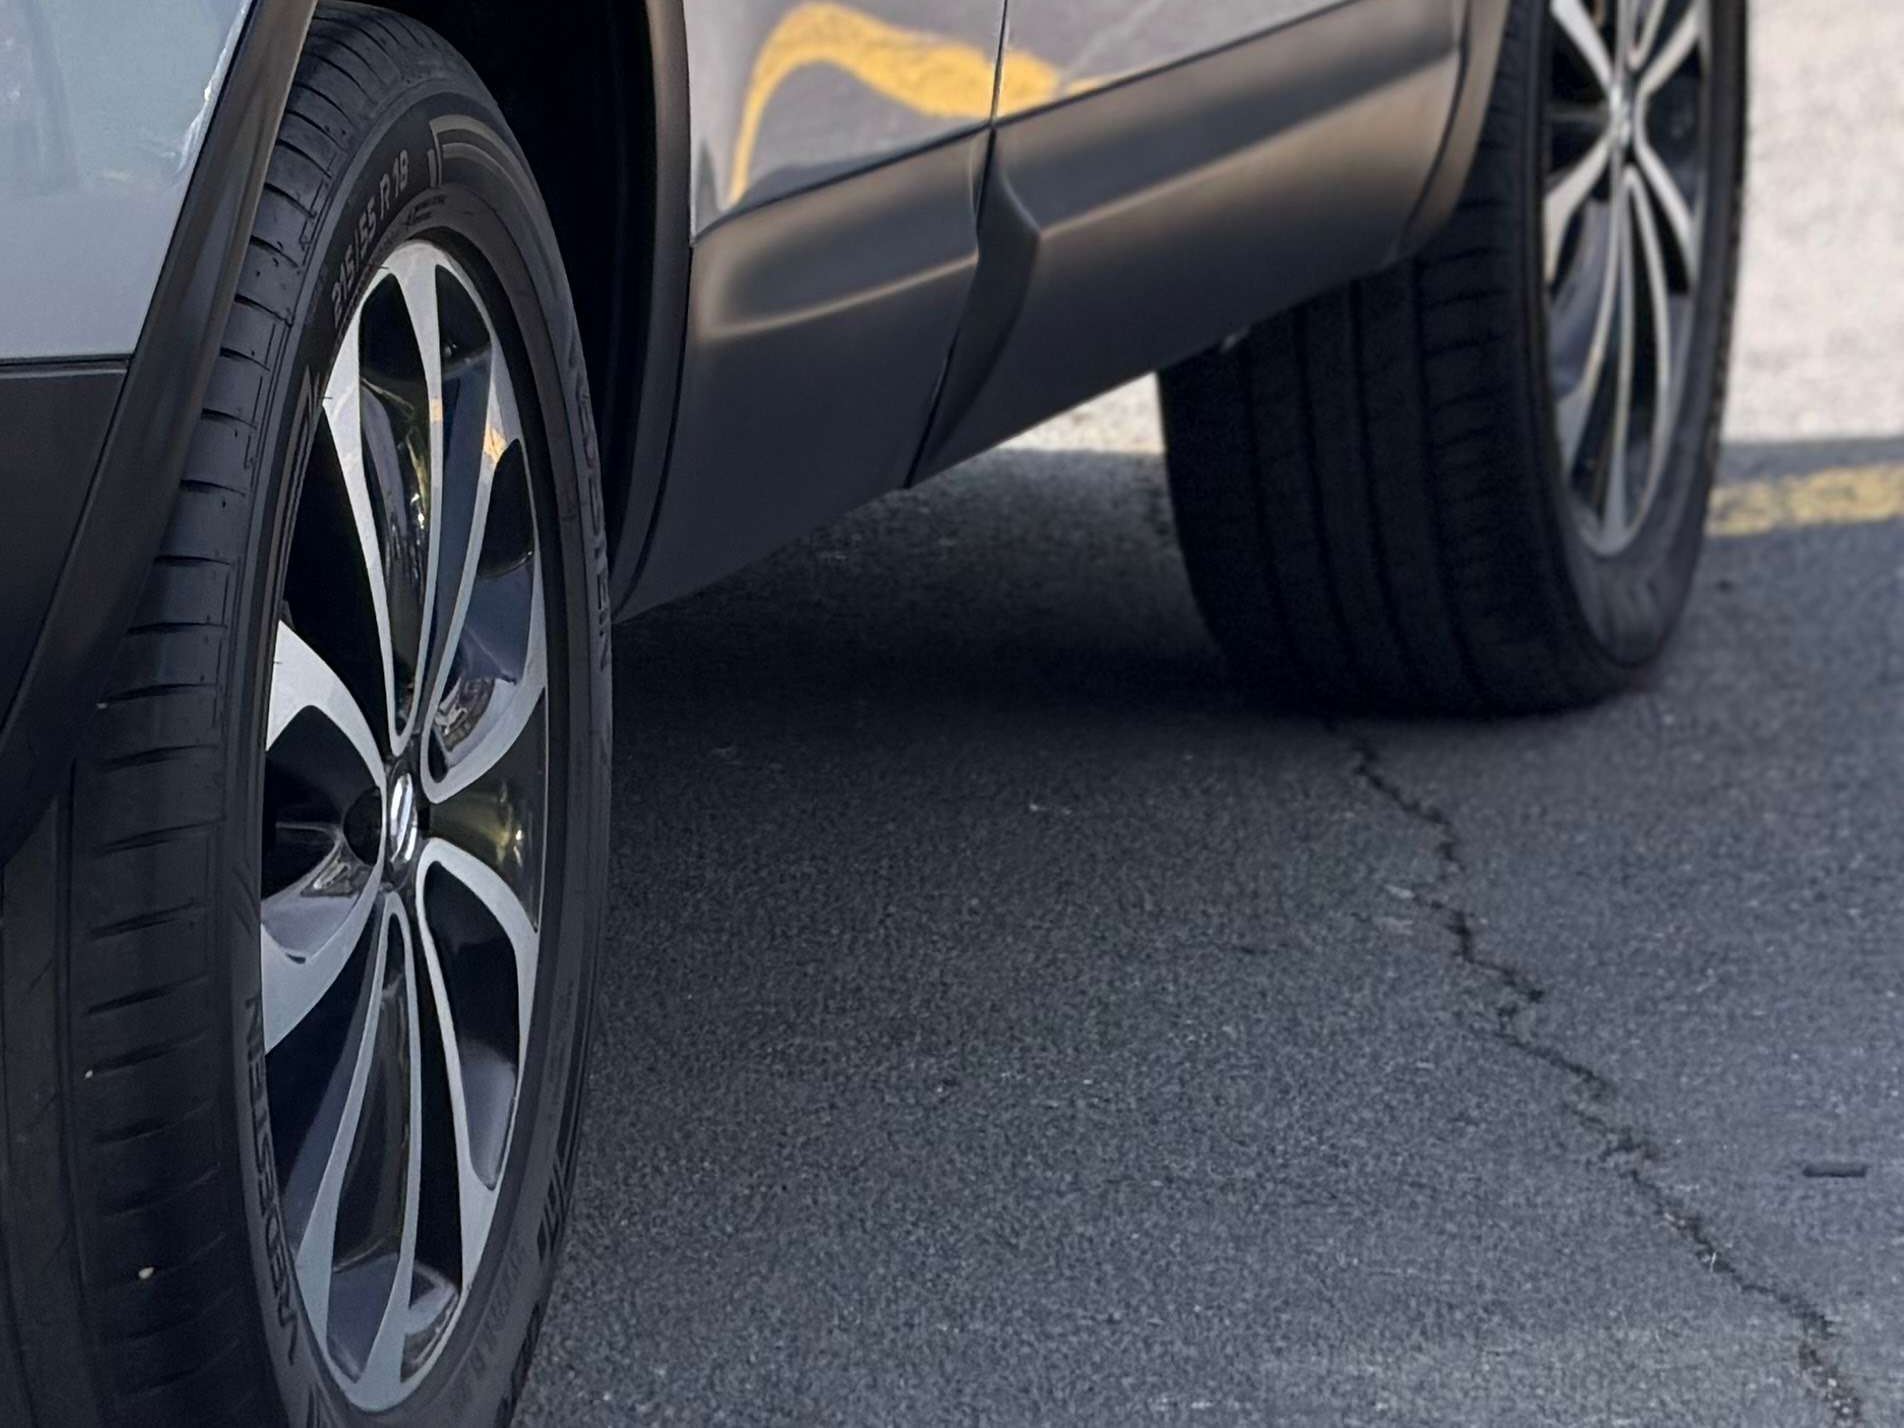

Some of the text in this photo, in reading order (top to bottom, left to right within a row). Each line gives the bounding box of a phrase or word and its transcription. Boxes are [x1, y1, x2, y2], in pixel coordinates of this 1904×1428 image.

[379, 172, 391, 221] R
[393, 148, 409, 199] 18
[245, 994, 298, 1367] VREDESTEIN
